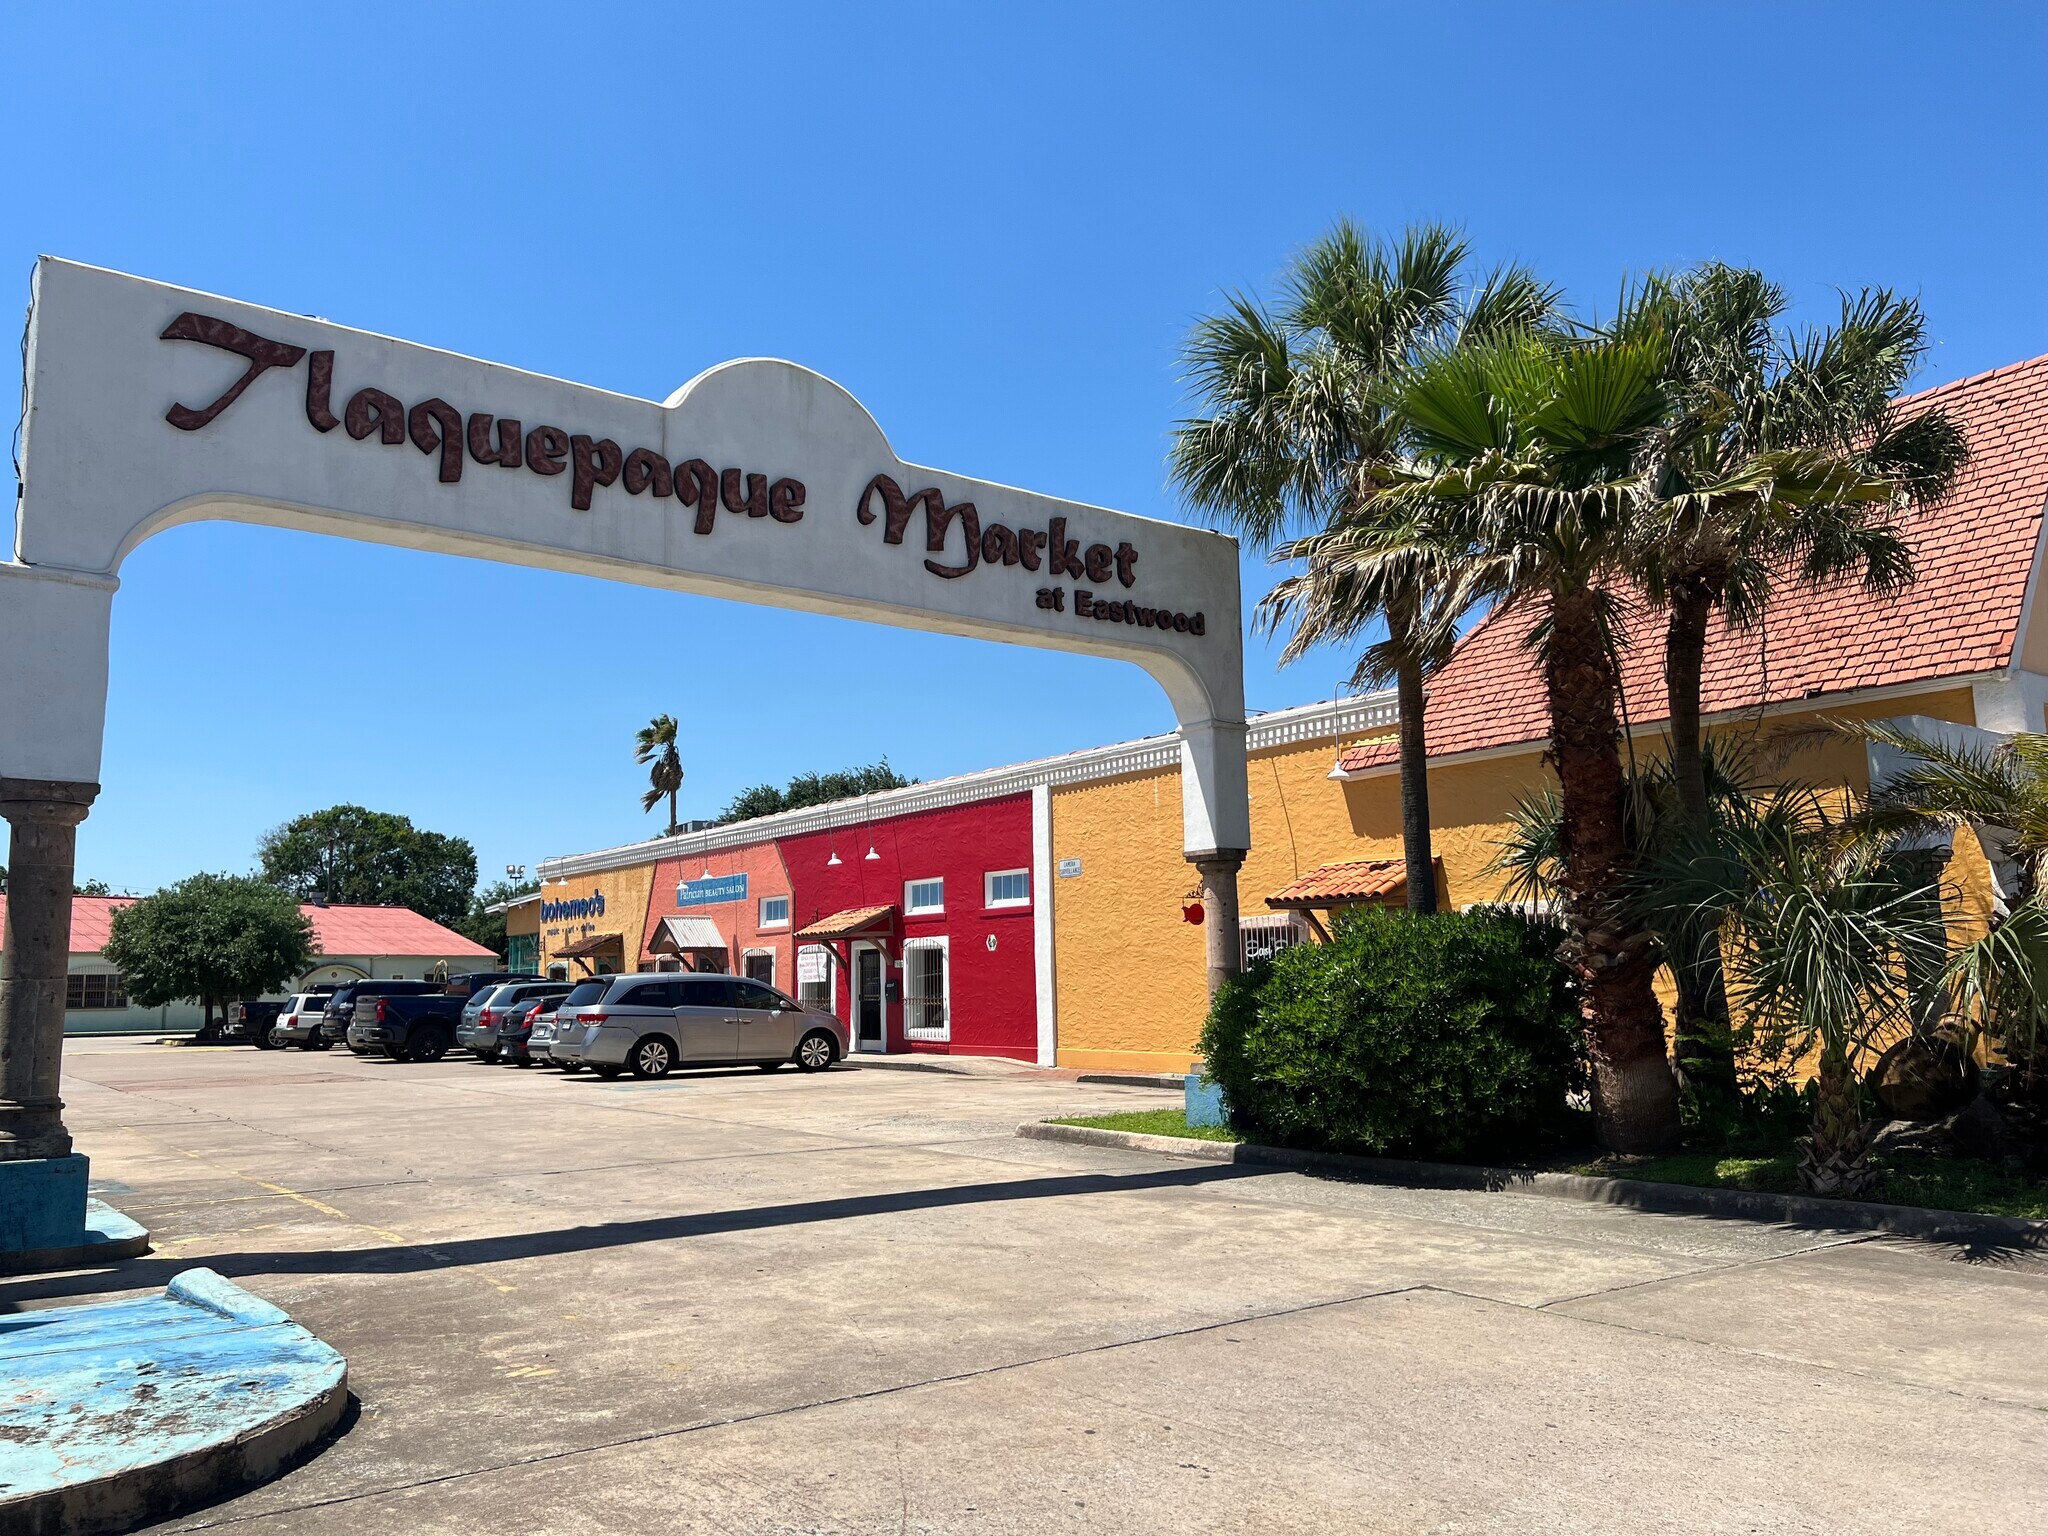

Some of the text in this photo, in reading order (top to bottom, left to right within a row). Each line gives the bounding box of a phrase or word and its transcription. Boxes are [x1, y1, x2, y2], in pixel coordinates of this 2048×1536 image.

[160, 311, 1139, 589] Tlaquepaque Market
[1035, 587, 1206, 636] at Eastwood
[541, 889, 605, 923] bohemeo's
[705, 887, 726, 898] BEAUTY
[726, 884, 745, 895] SALON
